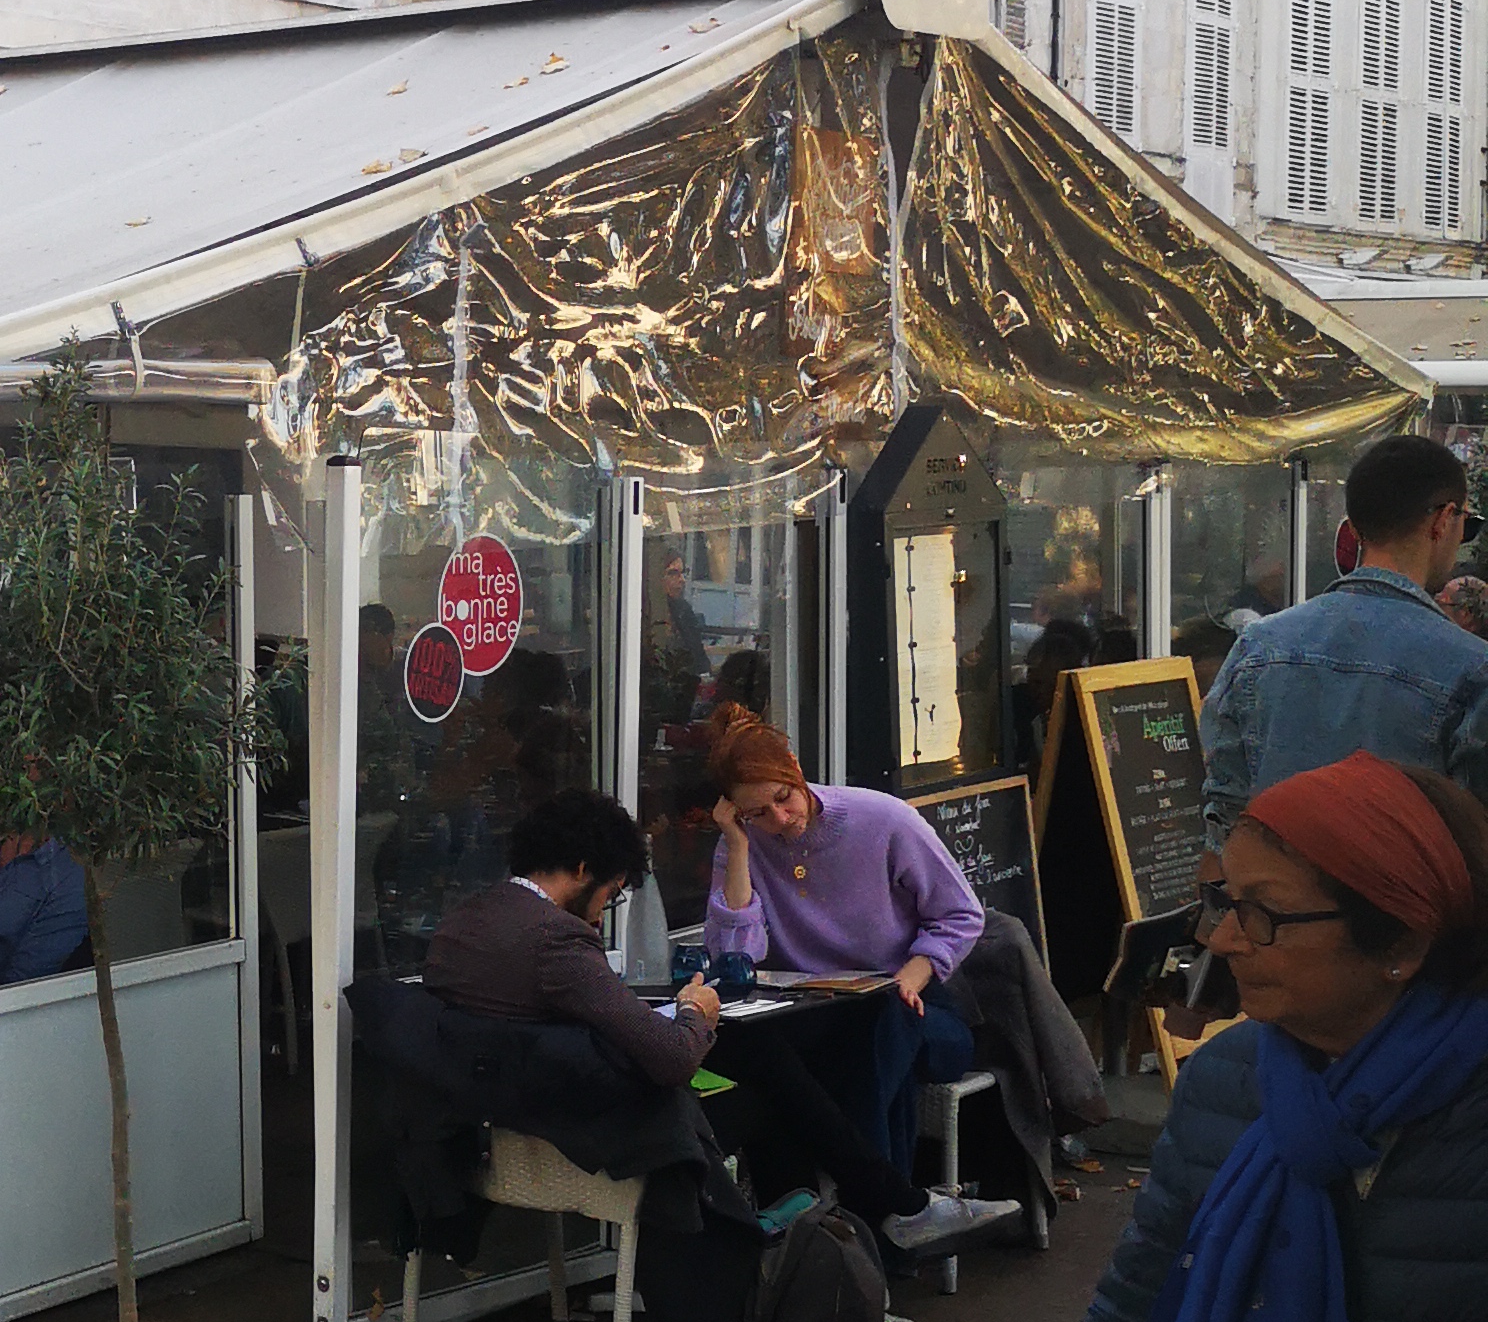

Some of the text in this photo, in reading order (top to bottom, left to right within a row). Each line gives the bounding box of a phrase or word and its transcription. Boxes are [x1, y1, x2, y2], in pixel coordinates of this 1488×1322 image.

[451, 551, 484, 575] ma
[477, 565, 516, 597] très
[441, 592, 509, 622] bonne
[463, 619, 519, 651] glace
